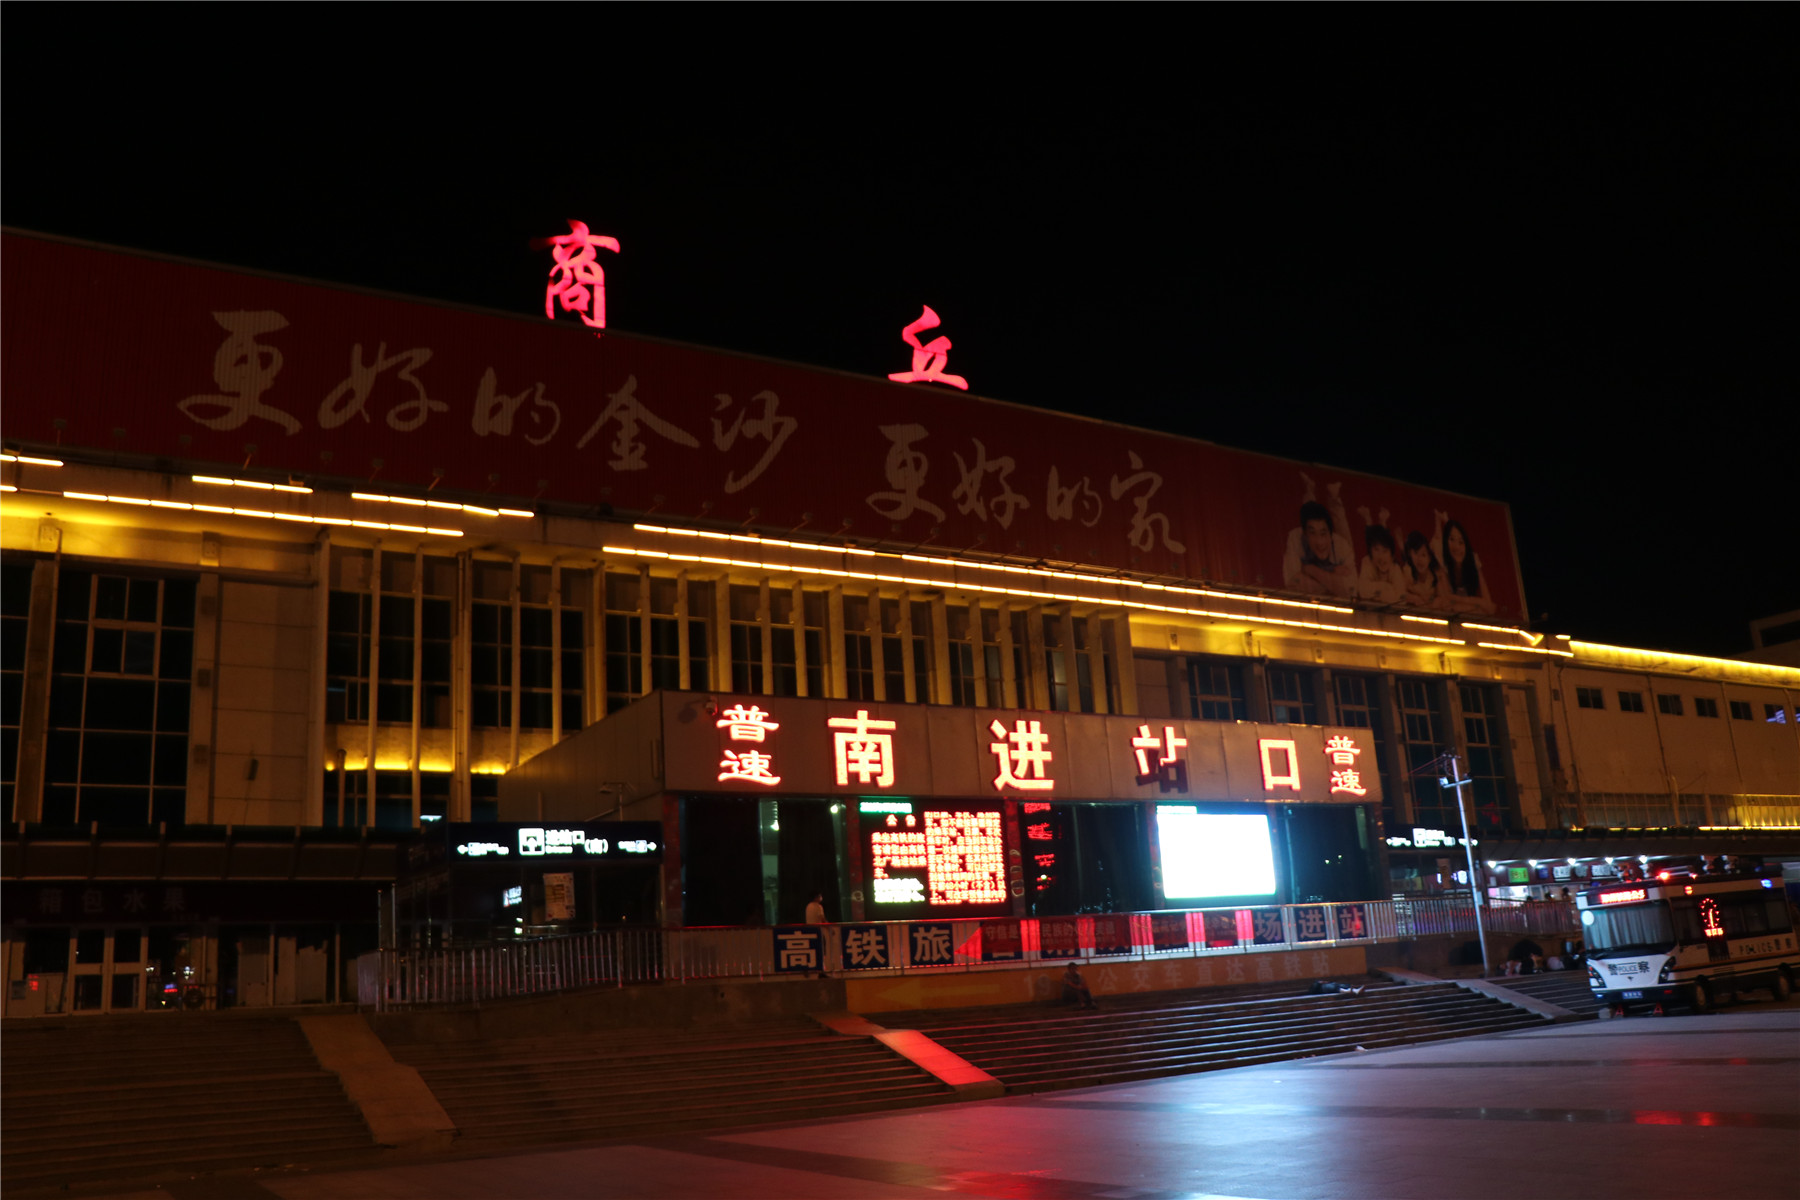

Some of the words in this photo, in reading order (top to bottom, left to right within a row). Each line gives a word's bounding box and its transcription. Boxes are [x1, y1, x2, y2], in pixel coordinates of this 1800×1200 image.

[176, 309, 798, 495] 更好的金沙
[865, 421, 1186, 555] 更好的家
[716, 704, 781, 785] 普速
[828, 710, 1301, 794] 南进站口
[1324, 735, 1367, 796] 普速
[38, 887, 187, 914] 箱包水果
